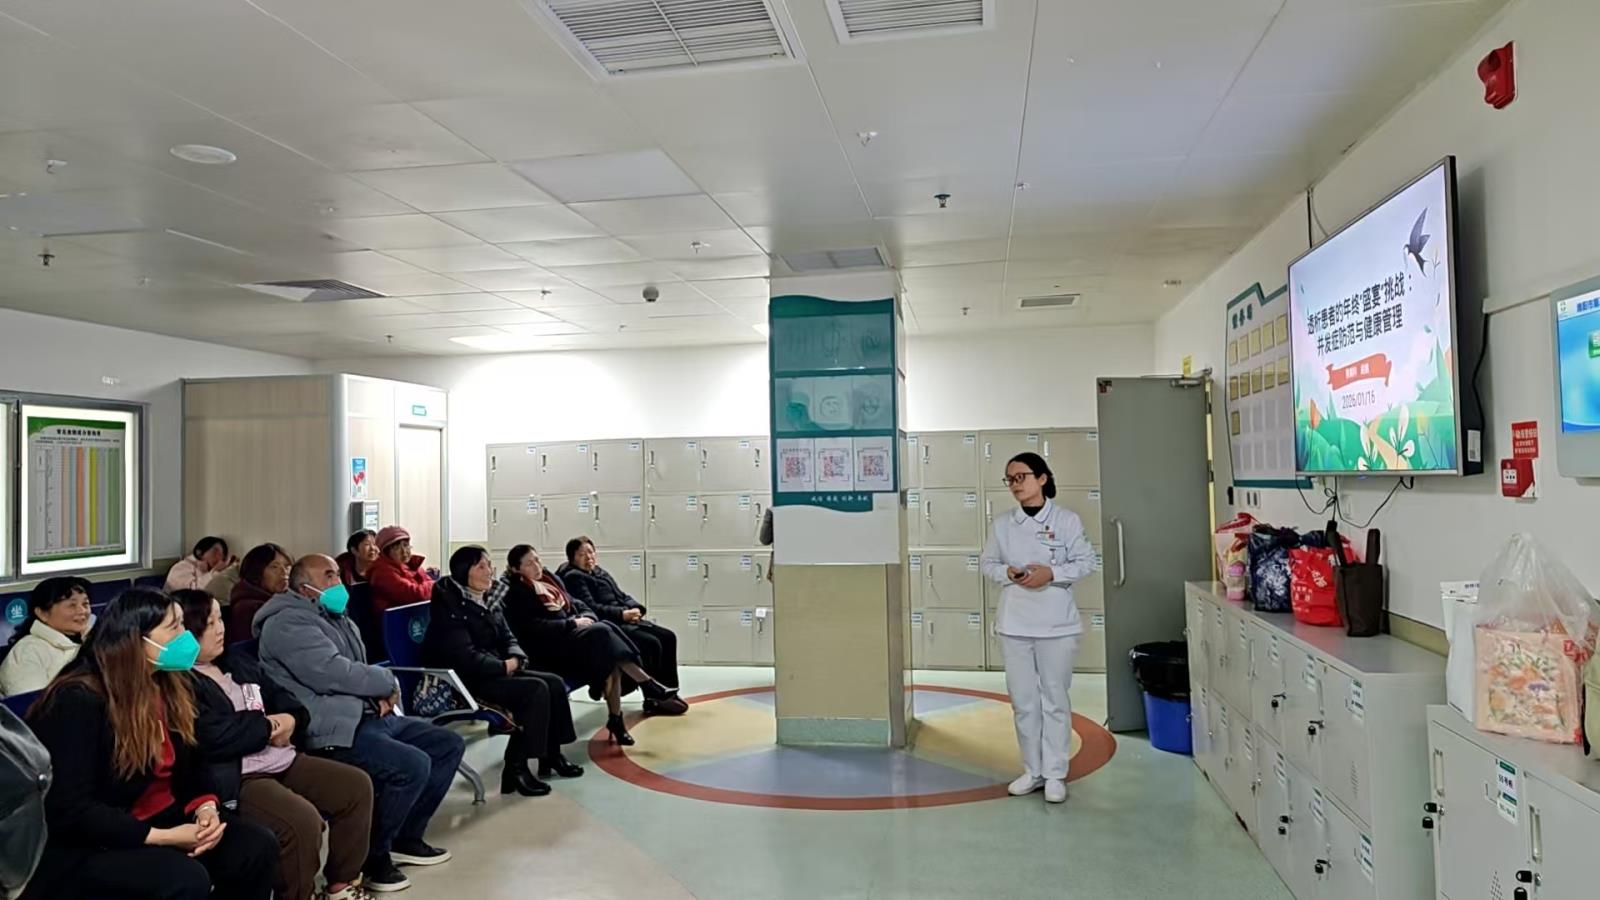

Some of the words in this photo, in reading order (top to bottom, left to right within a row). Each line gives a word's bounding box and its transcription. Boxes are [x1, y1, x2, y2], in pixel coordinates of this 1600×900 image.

[1317, 303, 1403, 357] 并发症防范与健康管理
